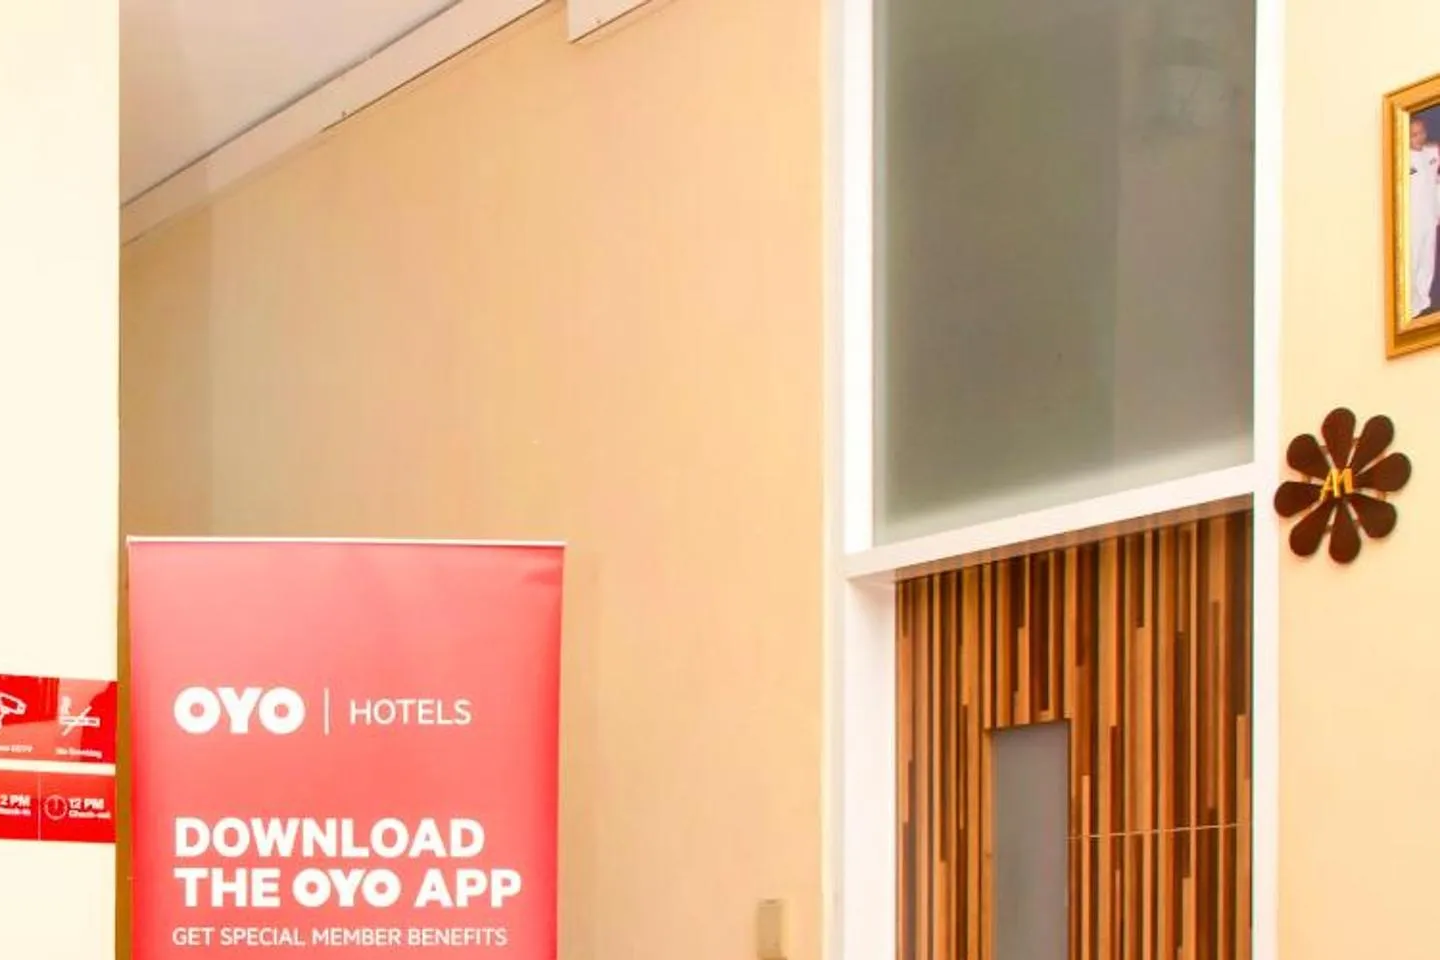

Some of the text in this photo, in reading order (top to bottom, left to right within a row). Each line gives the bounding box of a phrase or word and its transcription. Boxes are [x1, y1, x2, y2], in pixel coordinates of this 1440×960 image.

[173, 686, 472, 735] OYO HOTELS
[0, 794, 31, 807] 2 PM
[68, 797, 105, 810] 12 PM
[174, 816, 485, 858] DOWNLOAD
[173, 867, 523, 909] THE OYO APP
[172, 926, 508, 947] GET SPECIAL MEMBER BENEFITS
